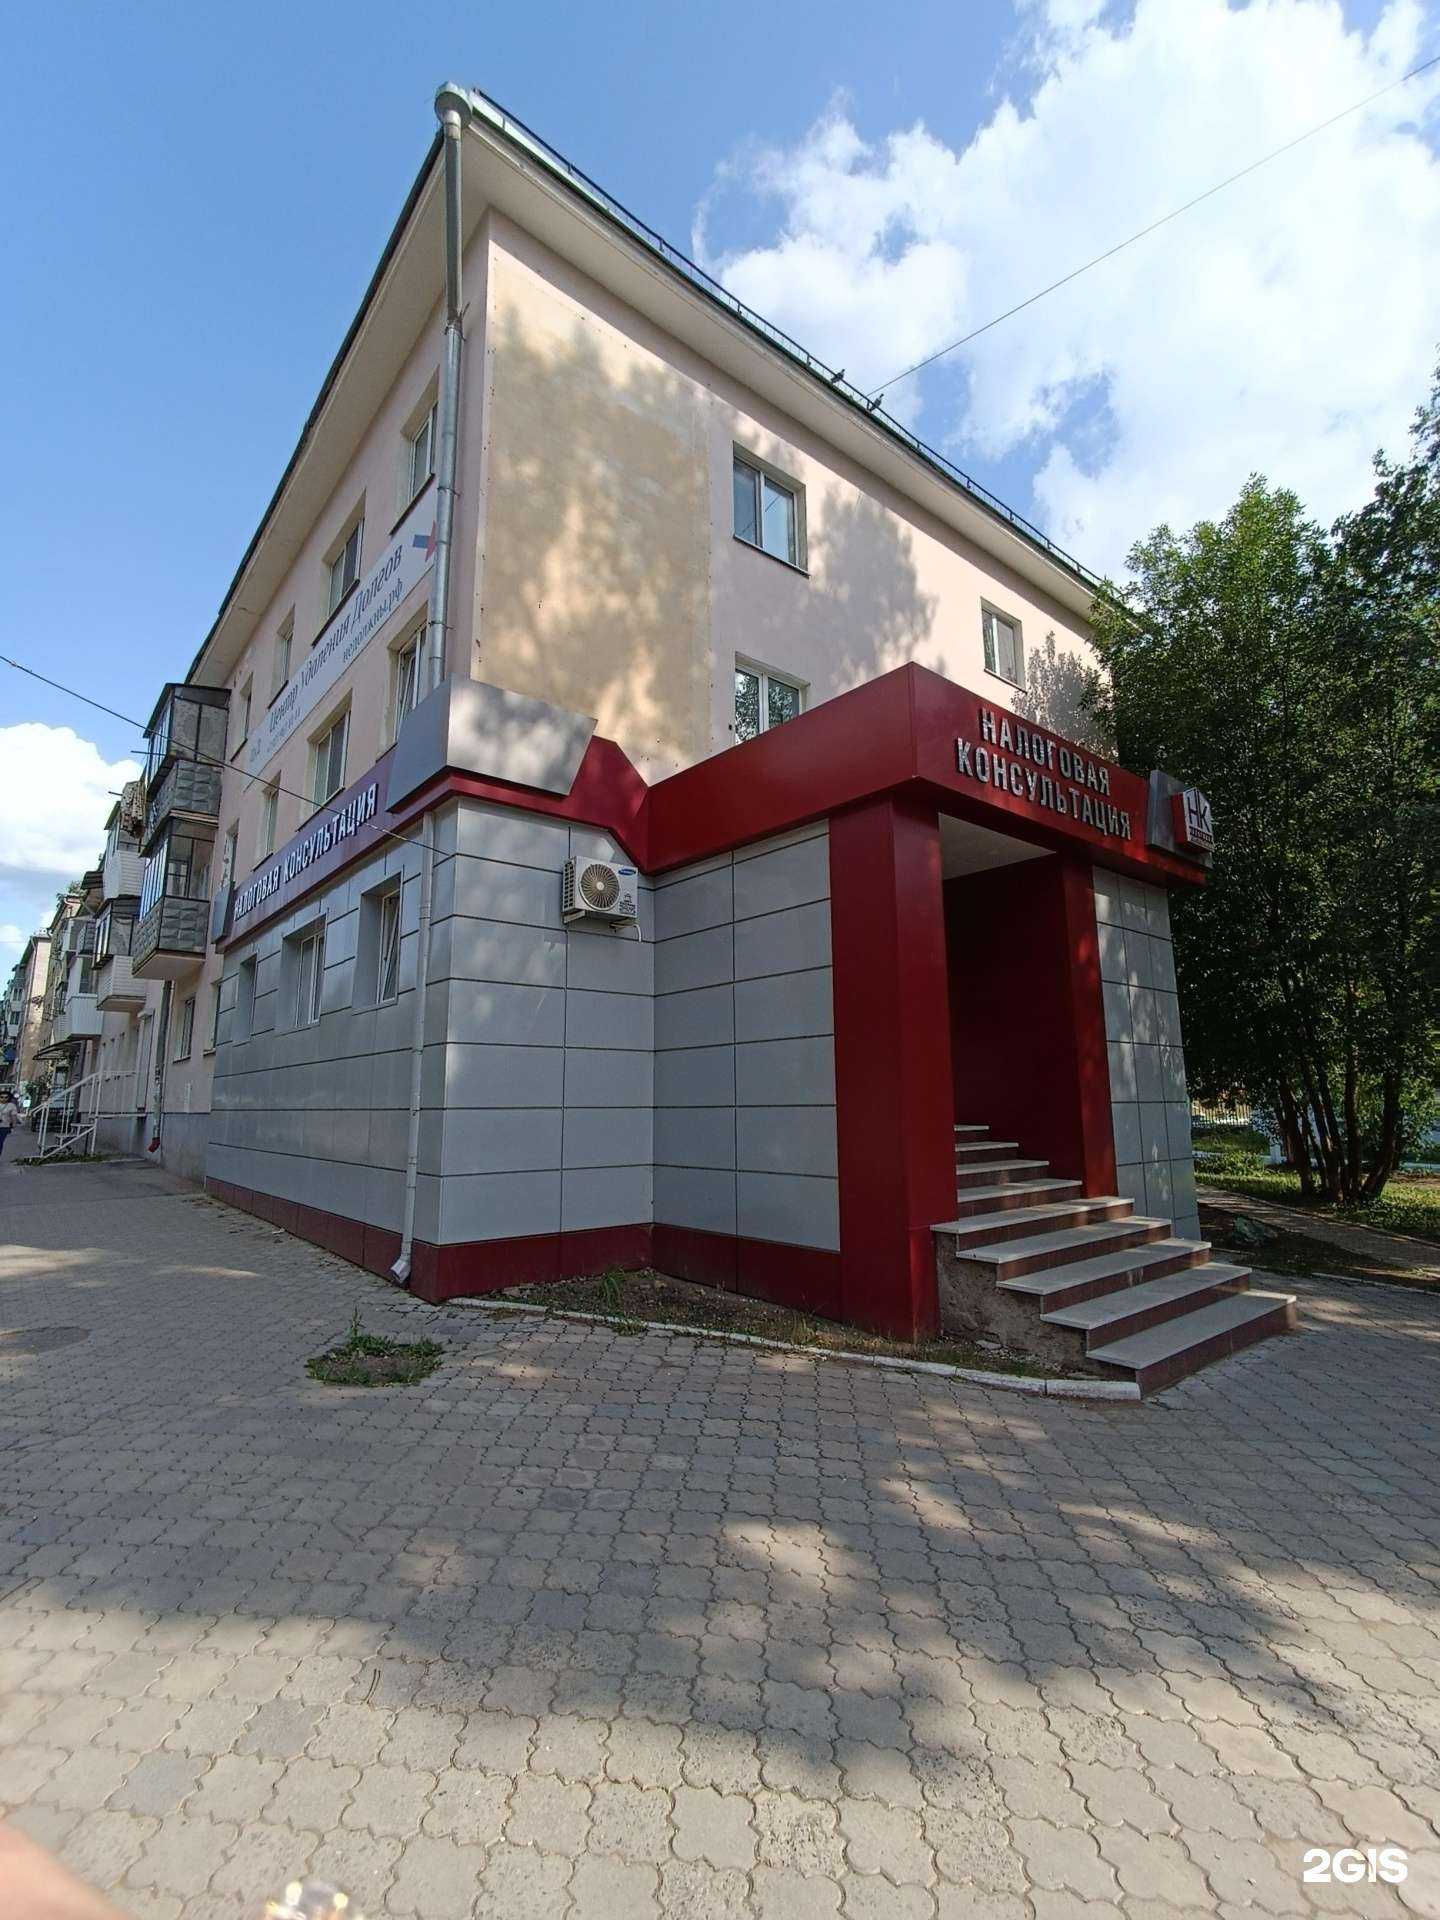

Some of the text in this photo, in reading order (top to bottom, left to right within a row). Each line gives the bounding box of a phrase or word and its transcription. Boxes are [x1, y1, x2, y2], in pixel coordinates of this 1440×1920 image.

[350, 545, 402, 634] Долгов
[956, 737, 1132, 840] КОНСУЛЬТАЦИЯ
[980, 706, 1111, 797] НАЛОГОВАЯ
[234, 782, 379, 922] НАЛОГОВАЯ КОНСУЛЬТАЦИЯ
[1187, 788, 1211, 833] НК
